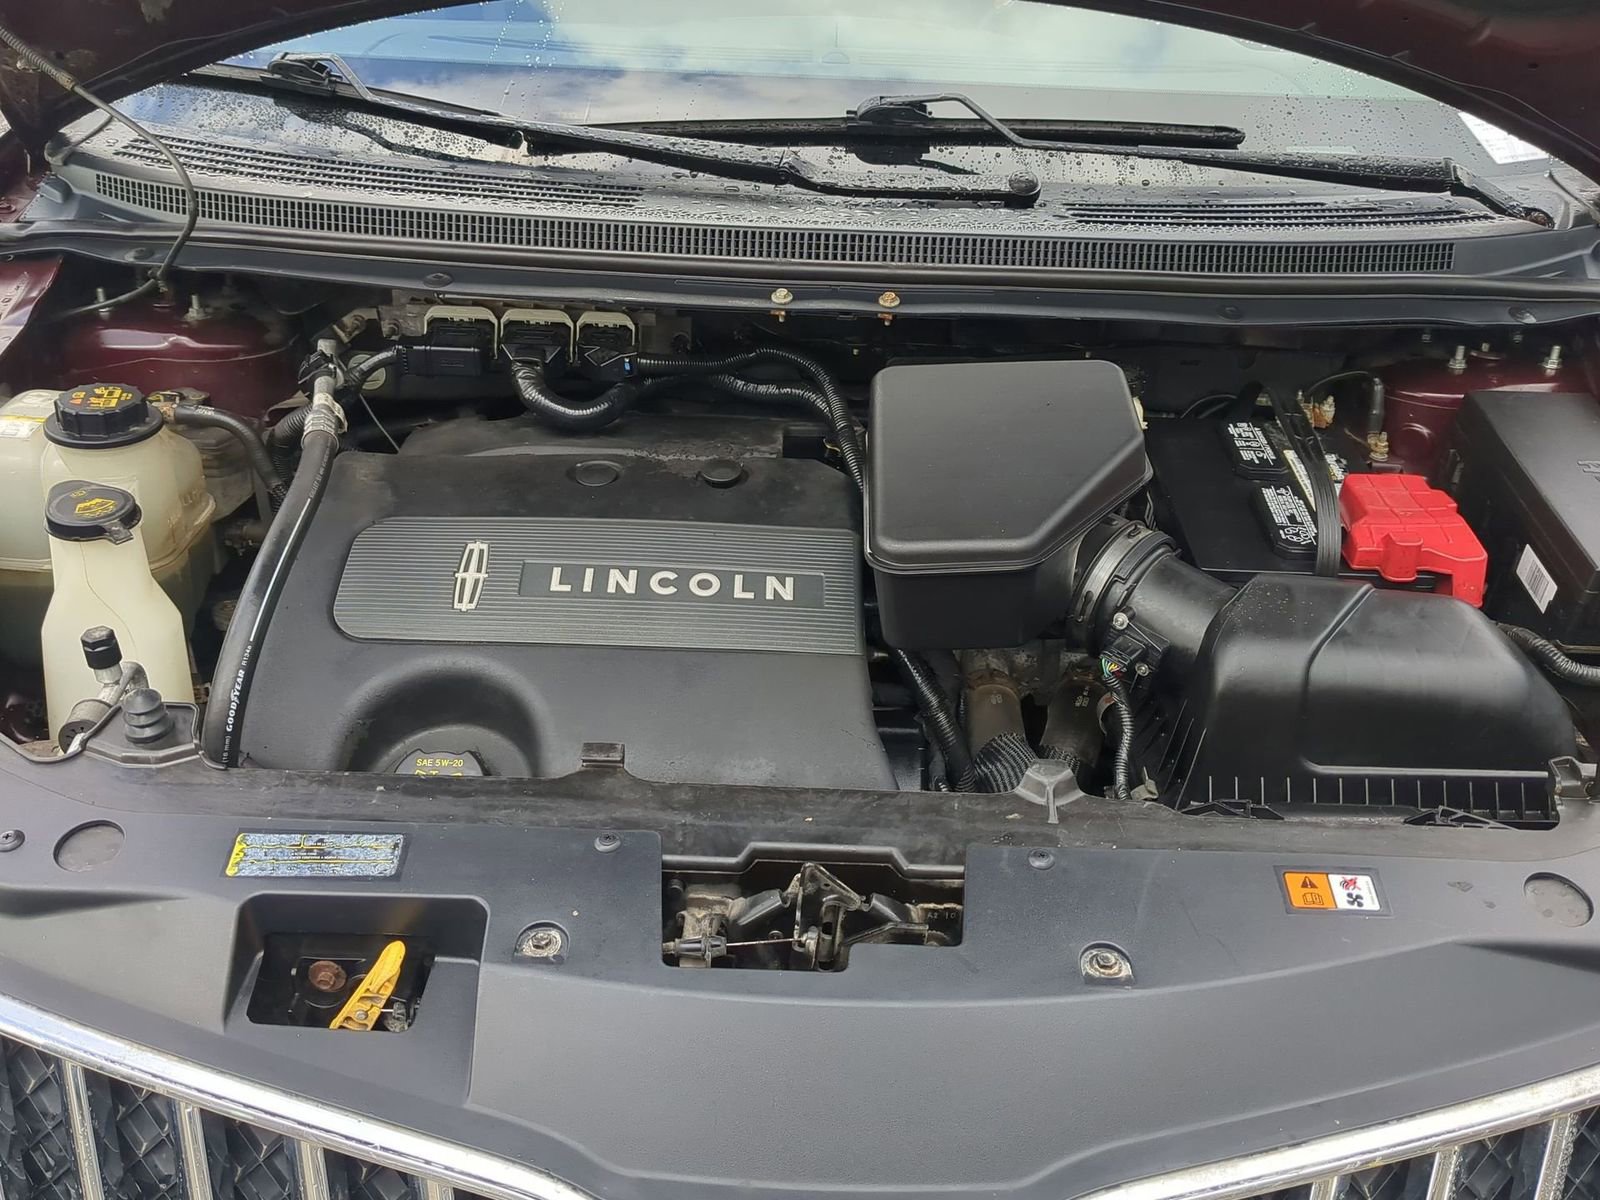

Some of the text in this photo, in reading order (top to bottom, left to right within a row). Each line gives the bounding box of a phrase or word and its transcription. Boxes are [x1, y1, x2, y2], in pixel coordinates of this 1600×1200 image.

[550, 567, 794, 601] LINCOLN
[226, 669, 245, 732] GOODYEAR
[241, 645, 252, 666] R134a
[415, 758, 464, 768] SAE 5W-20
